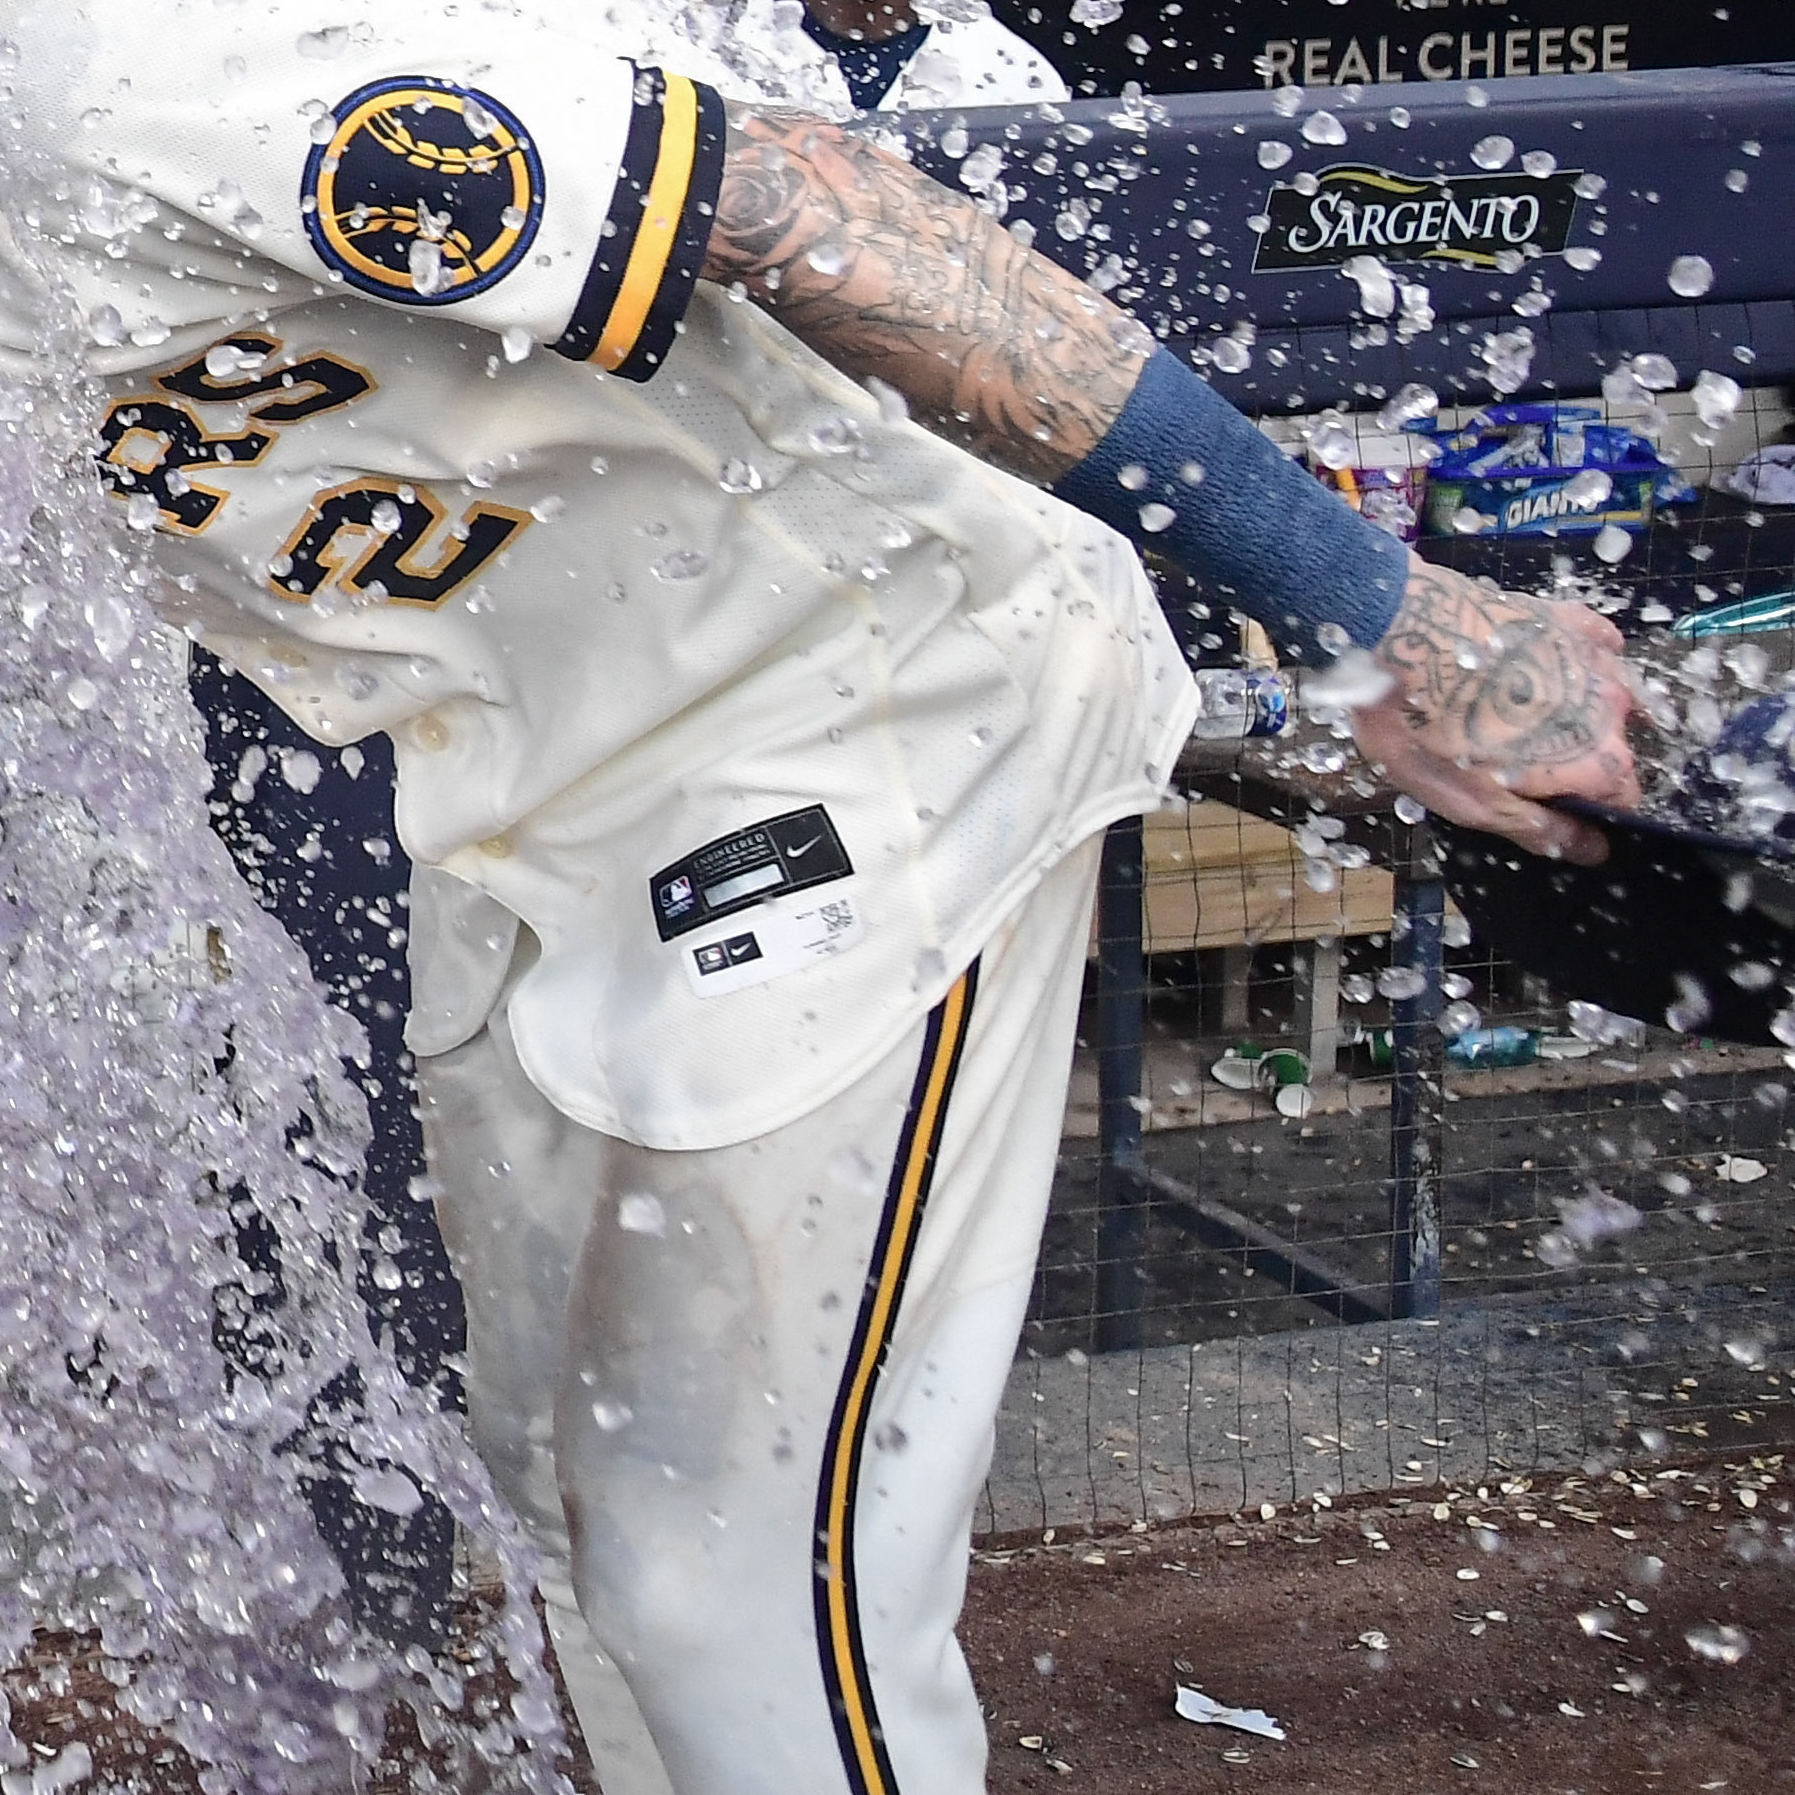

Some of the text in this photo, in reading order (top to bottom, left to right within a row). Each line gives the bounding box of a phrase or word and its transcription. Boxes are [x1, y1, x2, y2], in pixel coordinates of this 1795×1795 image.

[1264, 23, 1631, 89] REAL CHEESE
[1288, 192, 1540, 254] SARGENTO
